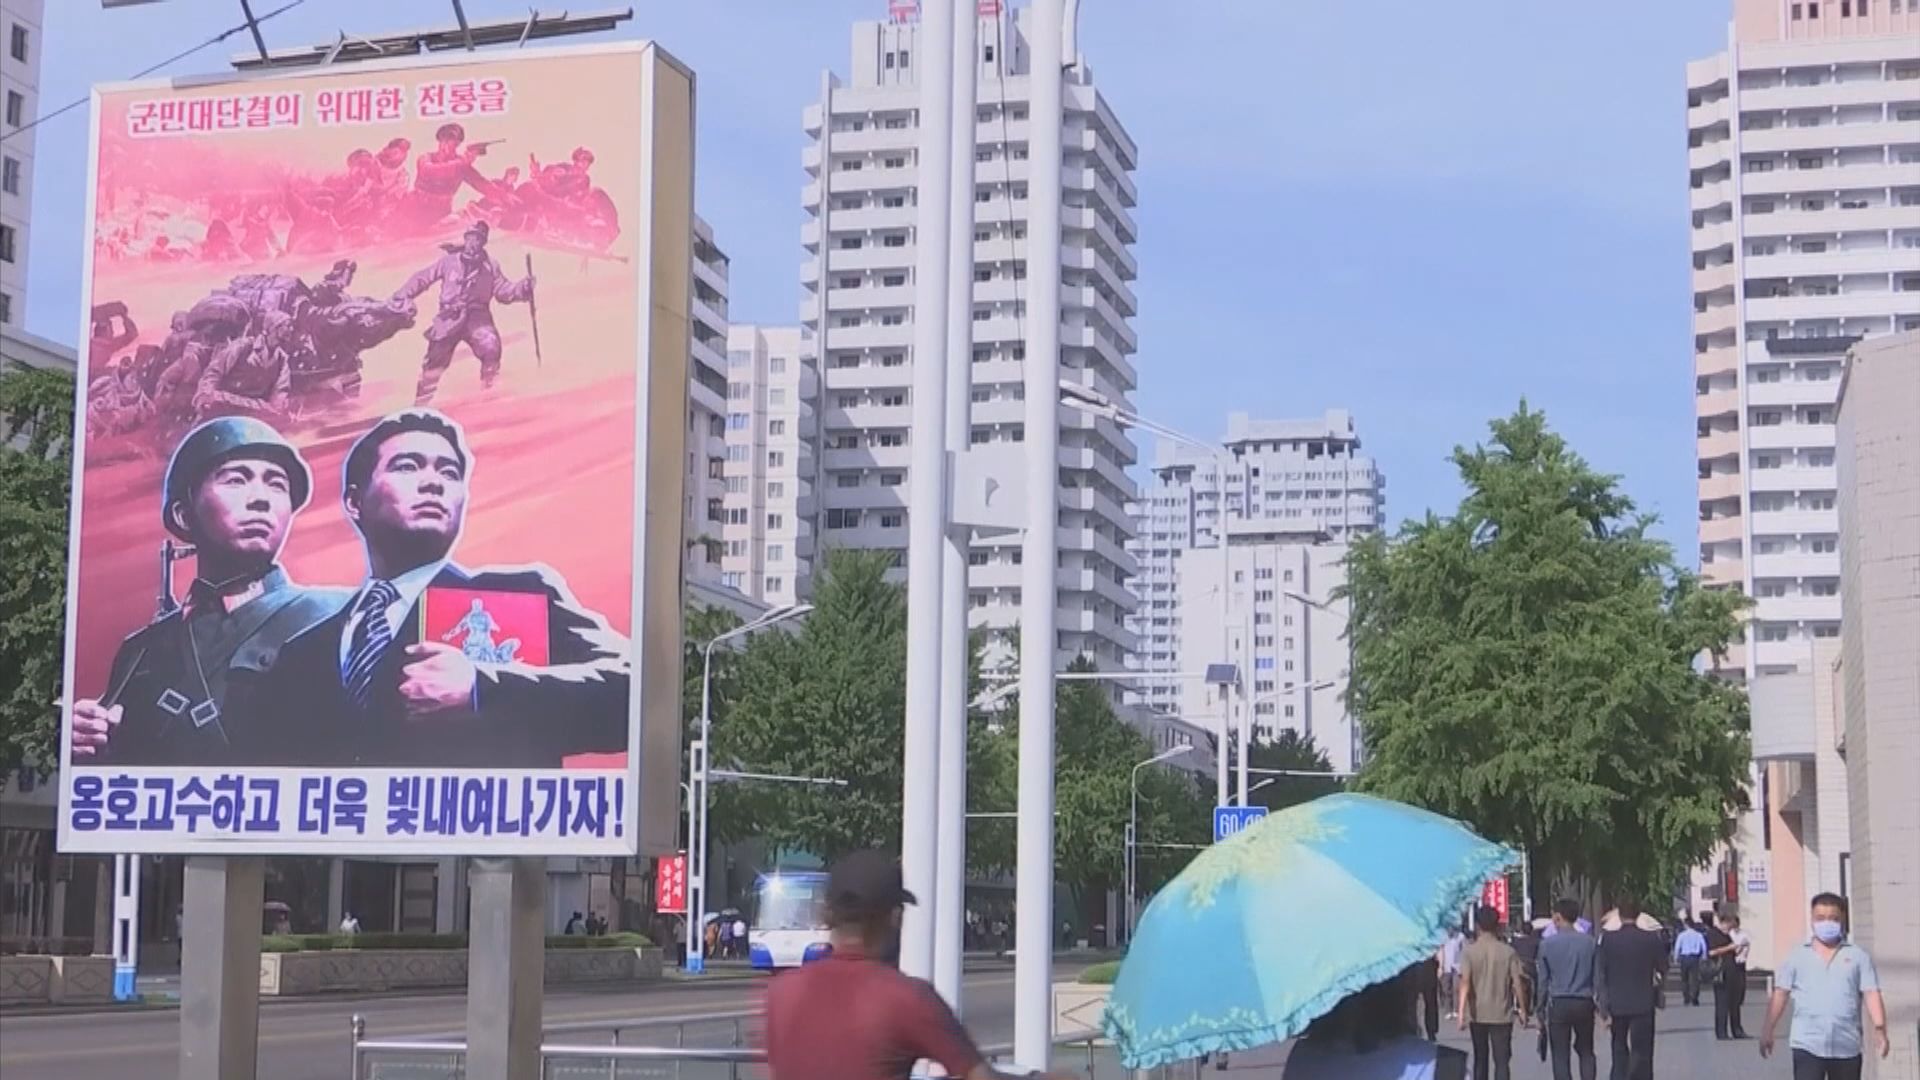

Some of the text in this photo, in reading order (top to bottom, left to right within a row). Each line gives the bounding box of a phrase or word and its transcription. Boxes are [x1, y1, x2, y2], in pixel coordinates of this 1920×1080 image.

[130, 94, 300, 133] 군민대단결의
[317, 88, 403, 124] 위대한
[71, 774, 624, 837] 옹호고수하고 더욱 빛내여나가자!
